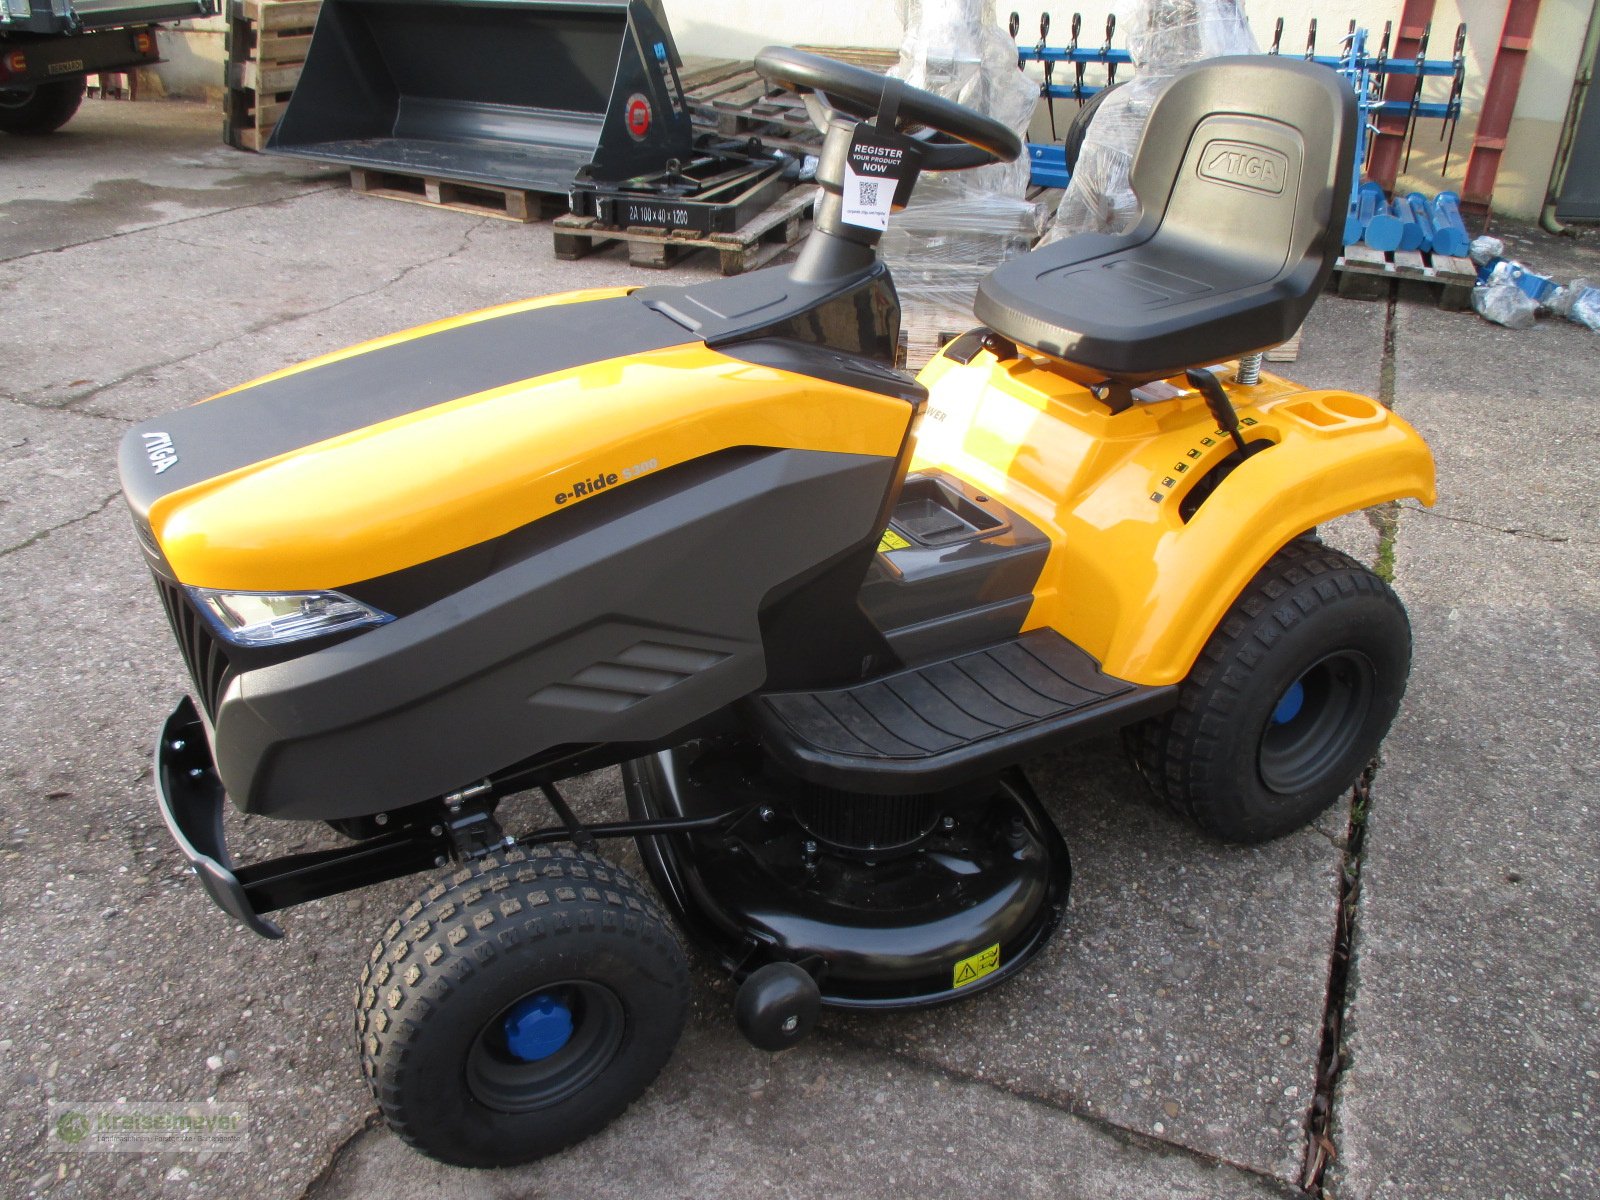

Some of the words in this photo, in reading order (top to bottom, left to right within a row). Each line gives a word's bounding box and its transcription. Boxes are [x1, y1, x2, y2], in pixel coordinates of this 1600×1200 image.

[853, 154, 870, 162] YOUR
[870, 156, 901, 165] PRODUCT
[854, 144, 903, 158] REGISTER
[862, 163, 888, 173] NOW
[1208, 151, 1279, 181] STIGA
[640, 207, 652, 222] 100
[657, 208, 666, 223] 40
[672, 210, 688, 225] 1200
[926, 406, 947, 422] WER
[142, 431, 178, 474] STIGA
[554, 473, 619, 505] e-Ride
